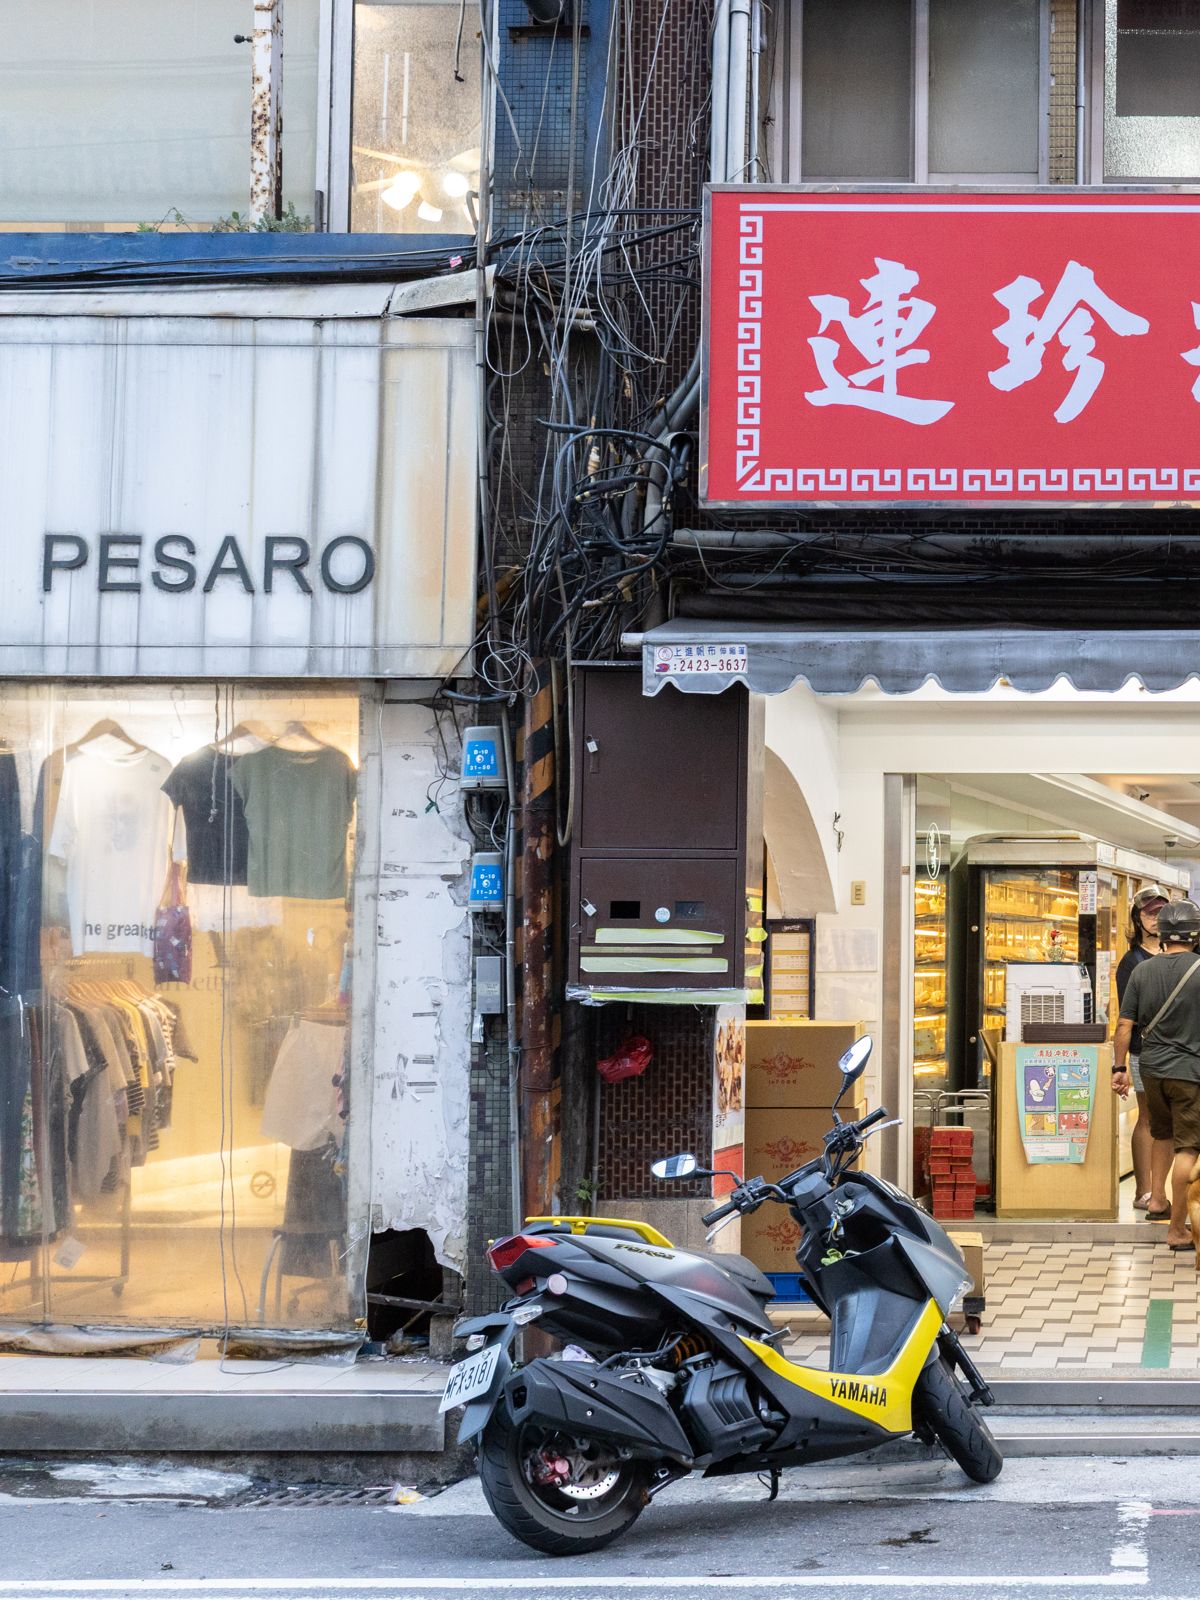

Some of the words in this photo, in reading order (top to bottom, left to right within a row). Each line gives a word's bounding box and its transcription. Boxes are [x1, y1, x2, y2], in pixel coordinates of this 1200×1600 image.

[42, 533, 375, 594] PESARO
[444, 1357, 494, 1401] MFX-3181
[830, 1378, 887, 1407] YAMAHA
